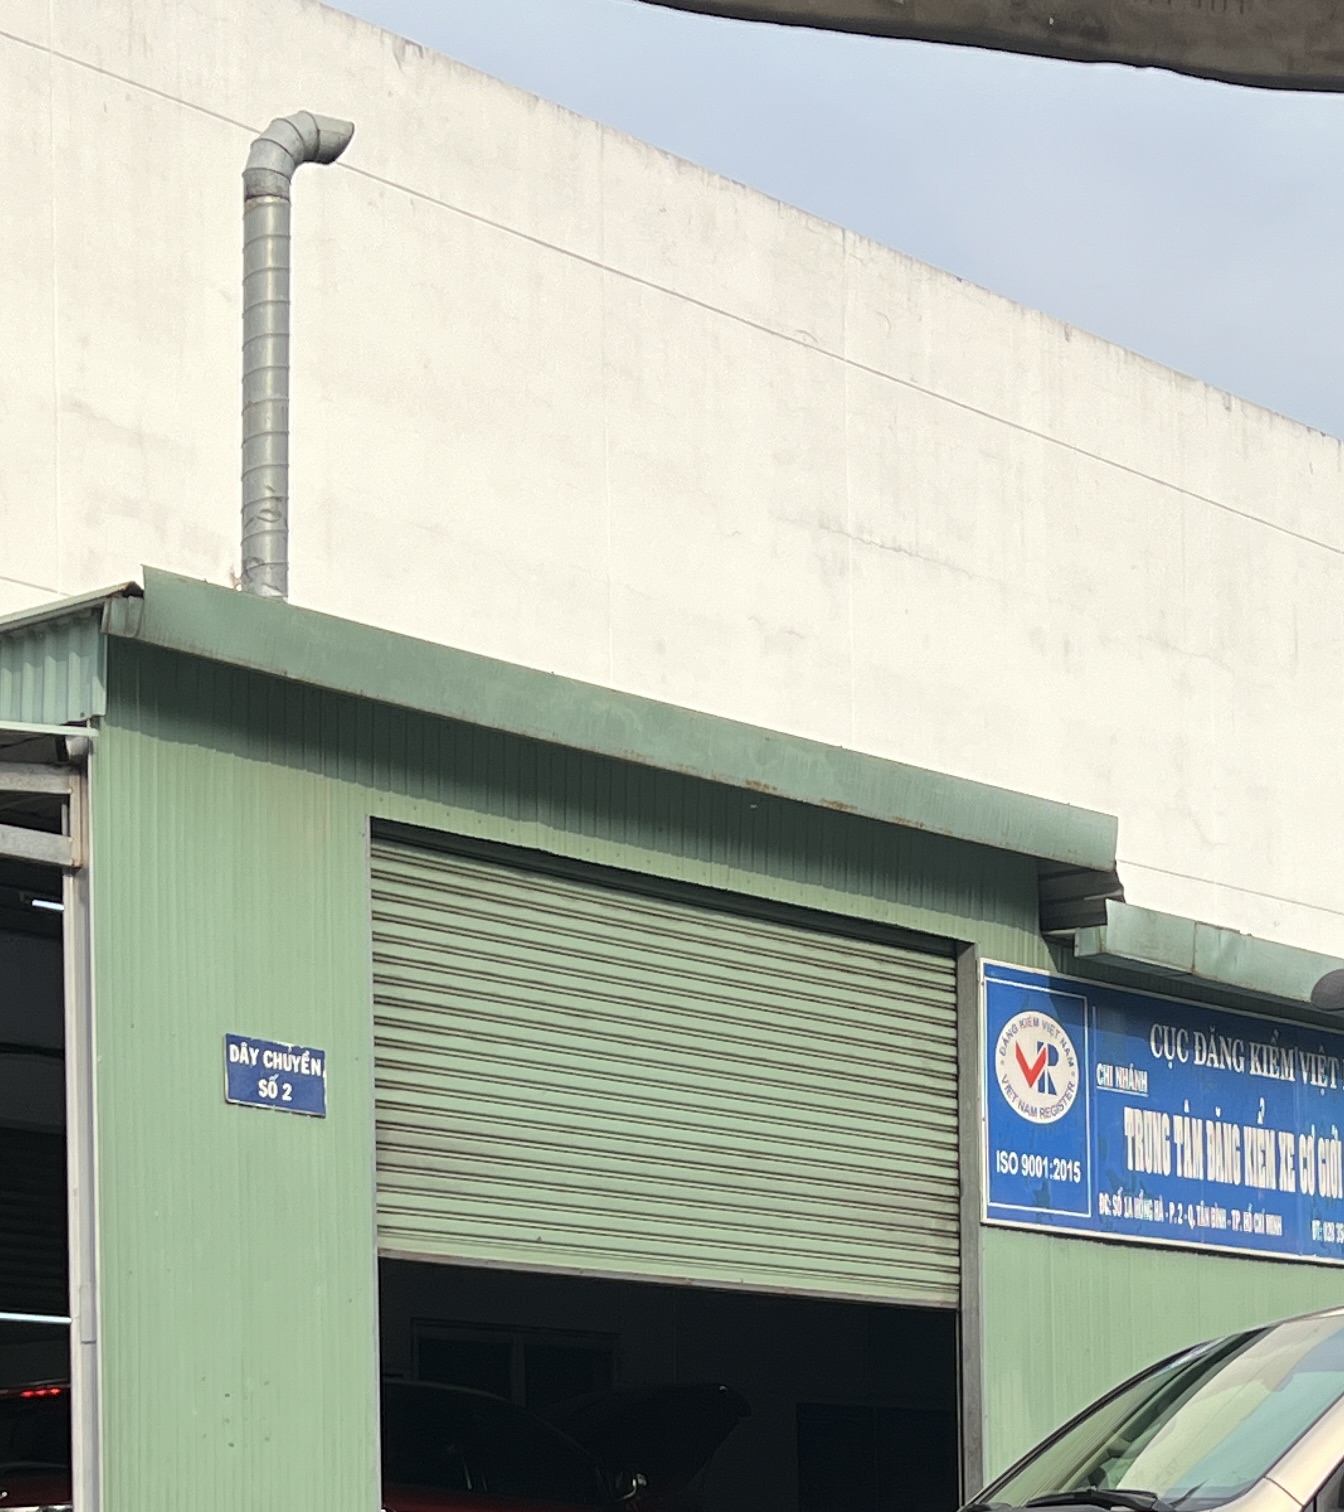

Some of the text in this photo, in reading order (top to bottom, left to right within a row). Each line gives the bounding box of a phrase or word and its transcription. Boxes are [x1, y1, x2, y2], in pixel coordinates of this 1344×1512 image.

[229, 1041, 260, 1067] DÂY
[1060, 1037, 1075, 1068] NAM
[1150, 1023, 1189, 1069] CỤC
[1194, 1026, 1244, 1074] ĐĂNG
[1249, 1029, 1296, 1082] KIỂM
[1300, 1045, 1337, 1095] VIỆT
[258, 1073, 293, 1101] SỐ 2
[1096, 1063, 1149, 1094] CHI NHÁNH
[1018, 1101, 1038, 1118] NAM
[1039, 1080, 1076, 1120] REGISTER
[1124, 1106, 1171, 1177] TRUNG
[1173, 1098, 1204, 1181] TÂM
[1243, 1096, 1277, 1191] KIỂM
[1278, 1130, 1296, 1193] XE
[1299, 1123, 1316, 1197] CƠ
[996, 1150, 1081, 1184] ISO 9001:2015
